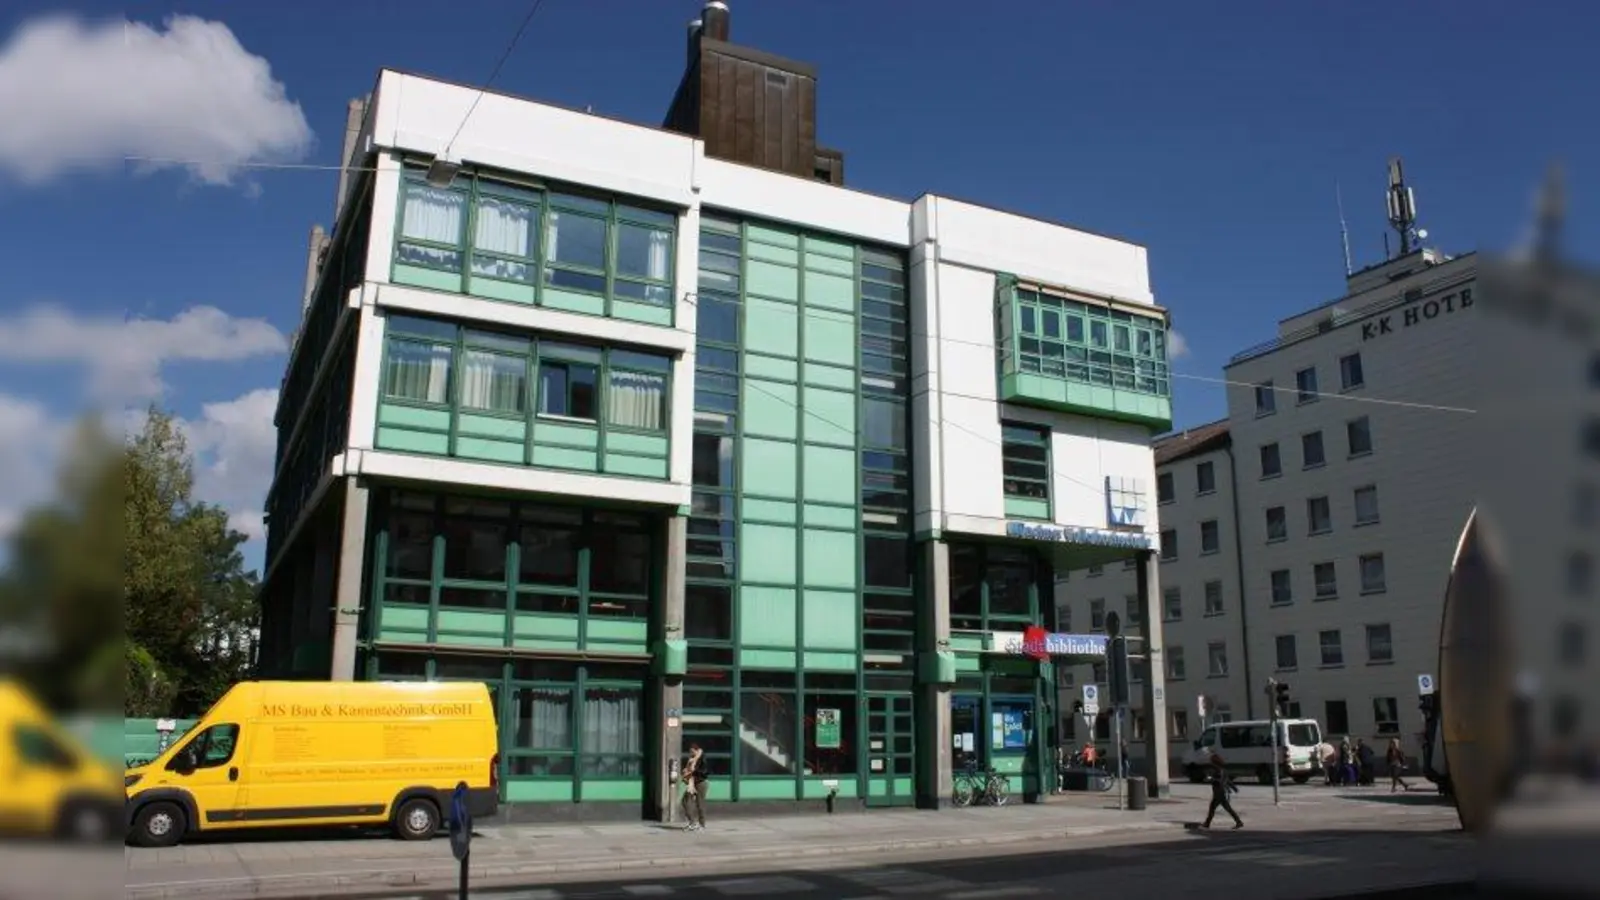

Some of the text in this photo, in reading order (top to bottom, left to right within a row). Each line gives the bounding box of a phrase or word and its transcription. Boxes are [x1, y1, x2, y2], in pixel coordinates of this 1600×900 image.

[1404, 289, 1474, 327] HOTE
[1004, 636, 1106, 654] Stadtbibliothe
[262, 704, 285, 717] MS
[291, 704, 317, 717] Bau
[321, 704, 333, 717] &
[432, 702, 473, 715] GmbH
